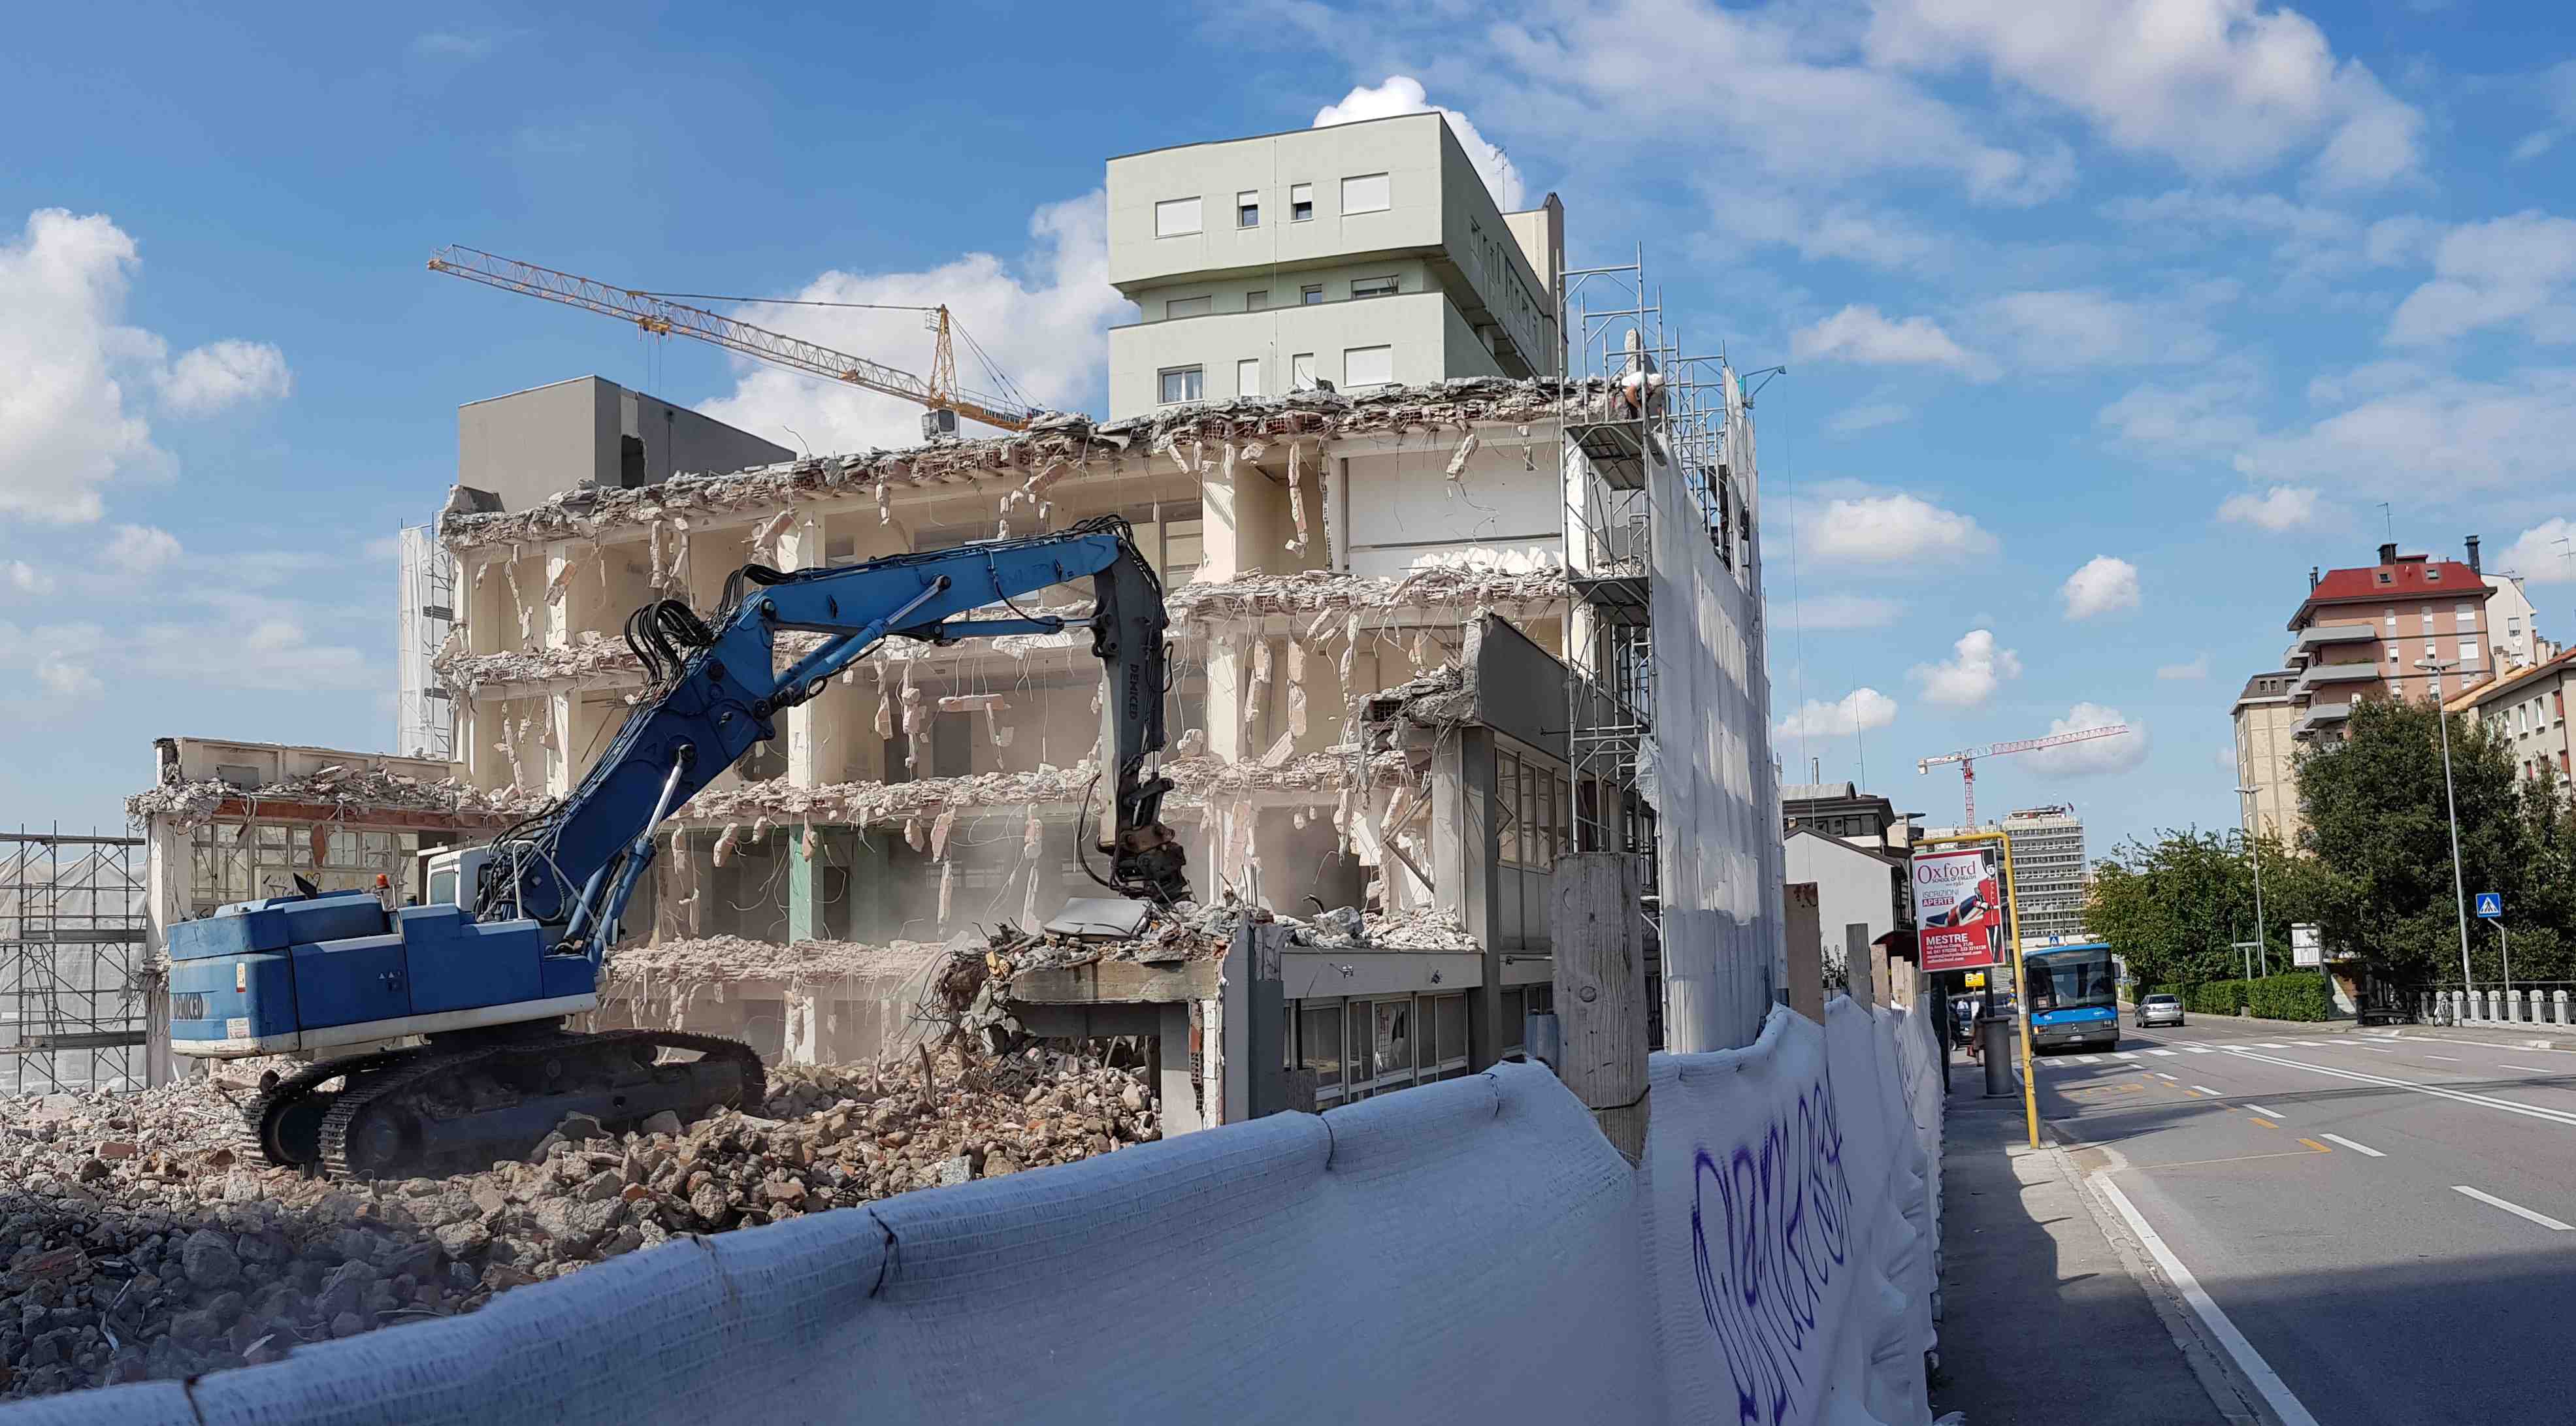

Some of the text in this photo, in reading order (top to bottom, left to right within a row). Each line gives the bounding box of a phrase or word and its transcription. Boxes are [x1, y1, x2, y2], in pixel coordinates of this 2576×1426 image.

[1129, 664, 1139, 720] DEMICED
[1917, 861, 1976, 884] Oxford
[1923, 889, 1959, 898] ISCRIZIONI
[1926, 933, 1968, 946] MESTRE
